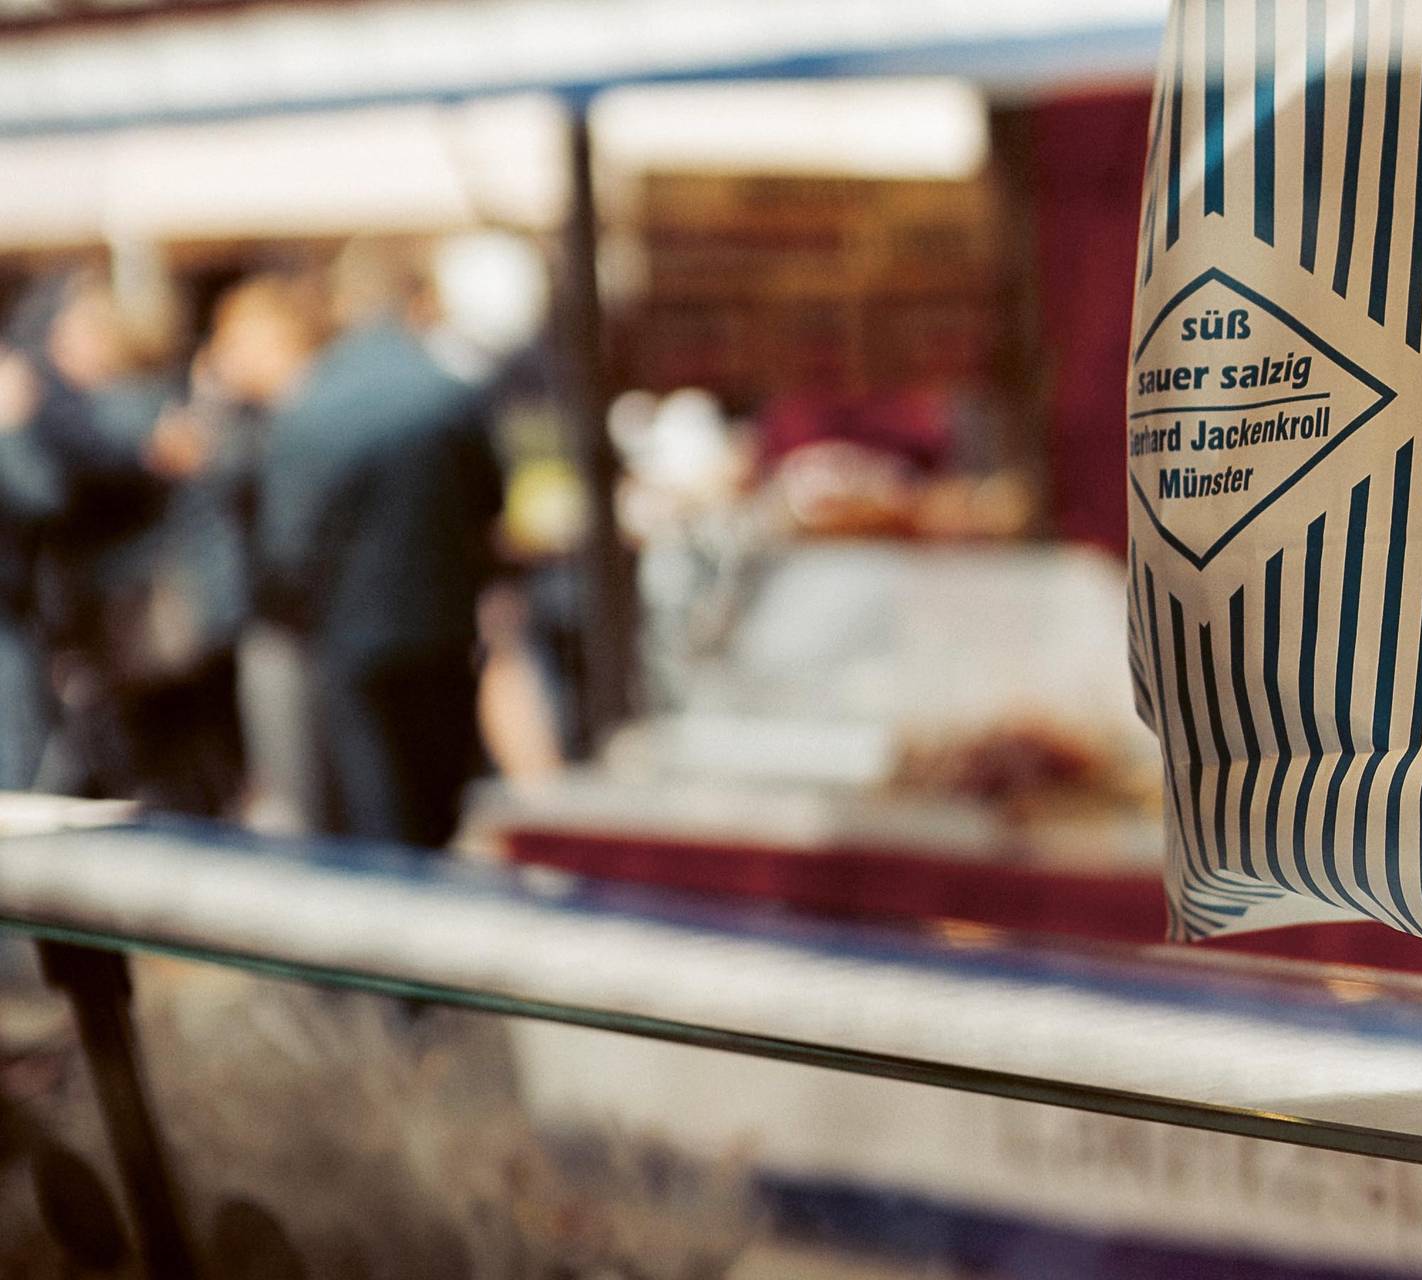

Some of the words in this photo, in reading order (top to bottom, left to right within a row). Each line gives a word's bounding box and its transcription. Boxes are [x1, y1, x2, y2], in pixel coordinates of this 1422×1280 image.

[1181, 309, 1251, 341] süß
[1138, 366, 1209, 395] sauer
[1220, 352, 1312, 389] salzig
[1190, 407, 1330, 451] Jackenkroll
[1159, 466, 1254, 499] Münster
